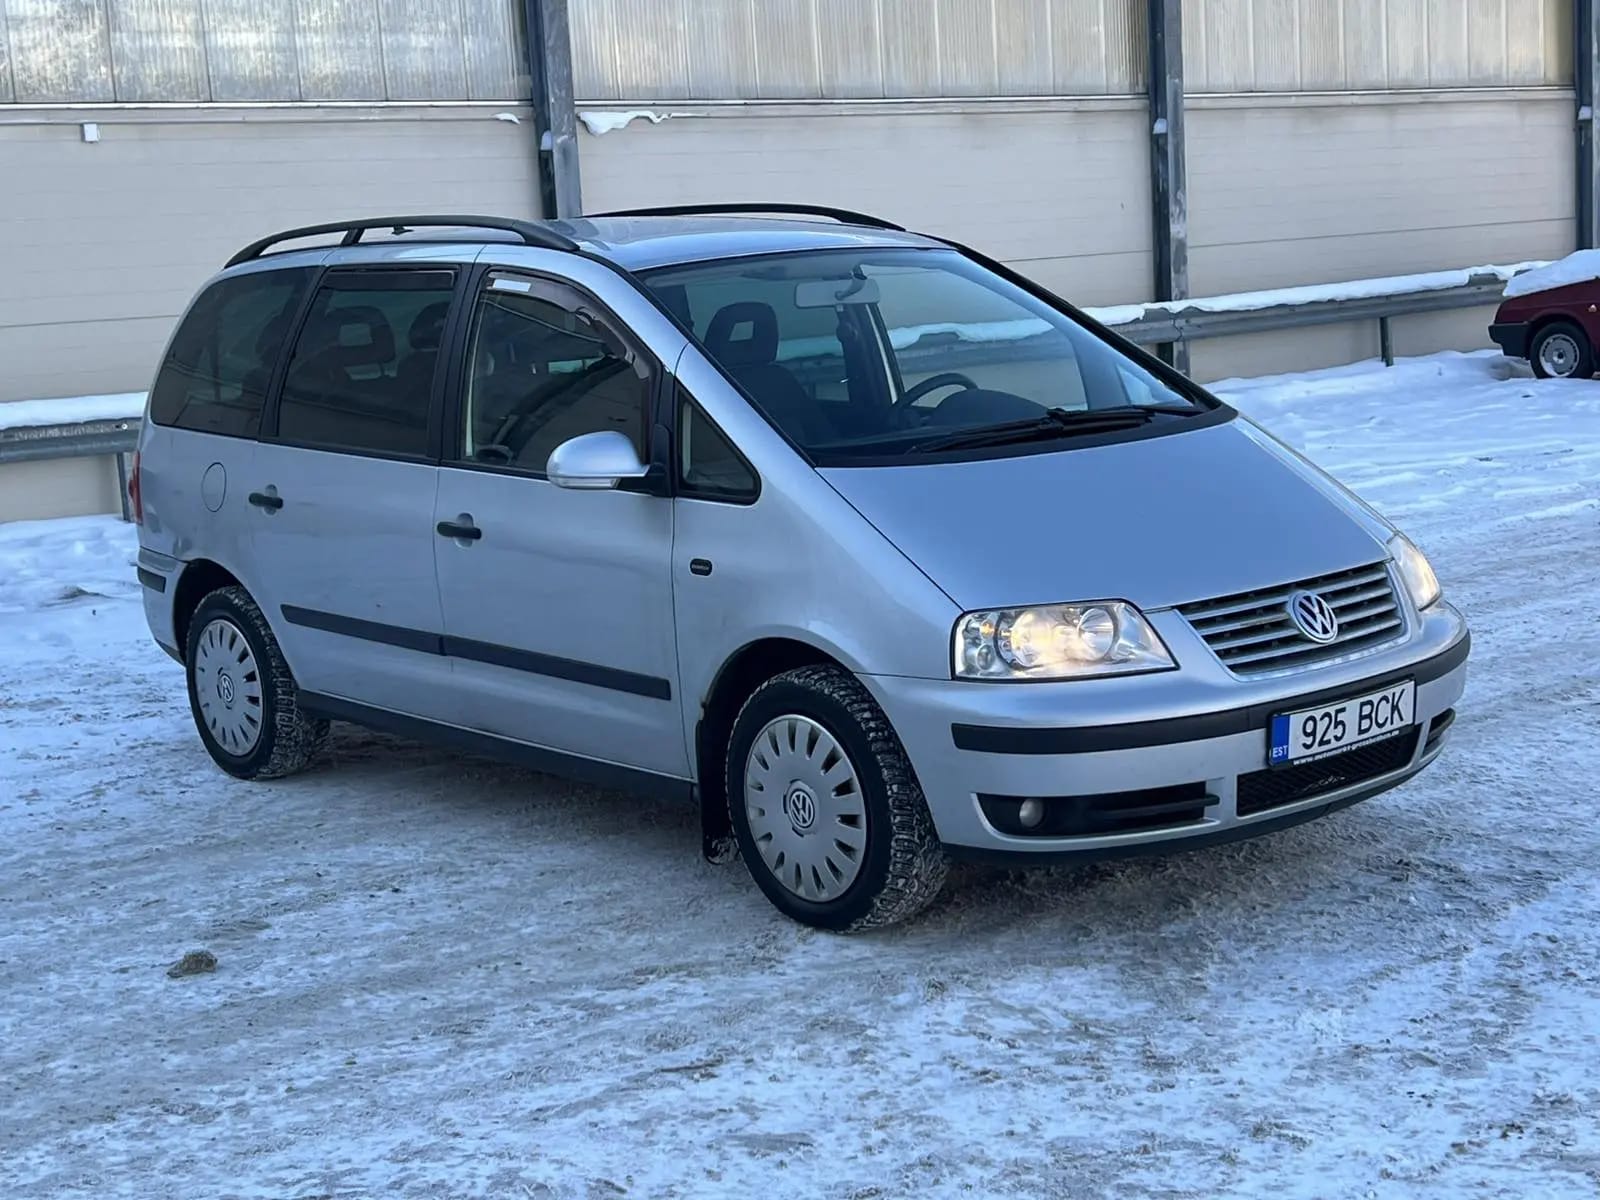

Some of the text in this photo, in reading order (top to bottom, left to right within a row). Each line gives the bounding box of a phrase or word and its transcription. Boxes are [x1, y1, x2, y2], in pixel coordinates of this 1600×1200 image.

[1291, 591, 1337, 641] VW
[1302, 688, 1405, 750] 925 BCK
[1272, 745, 1288, 758] EST
[791, 791, 814, 827] VW
